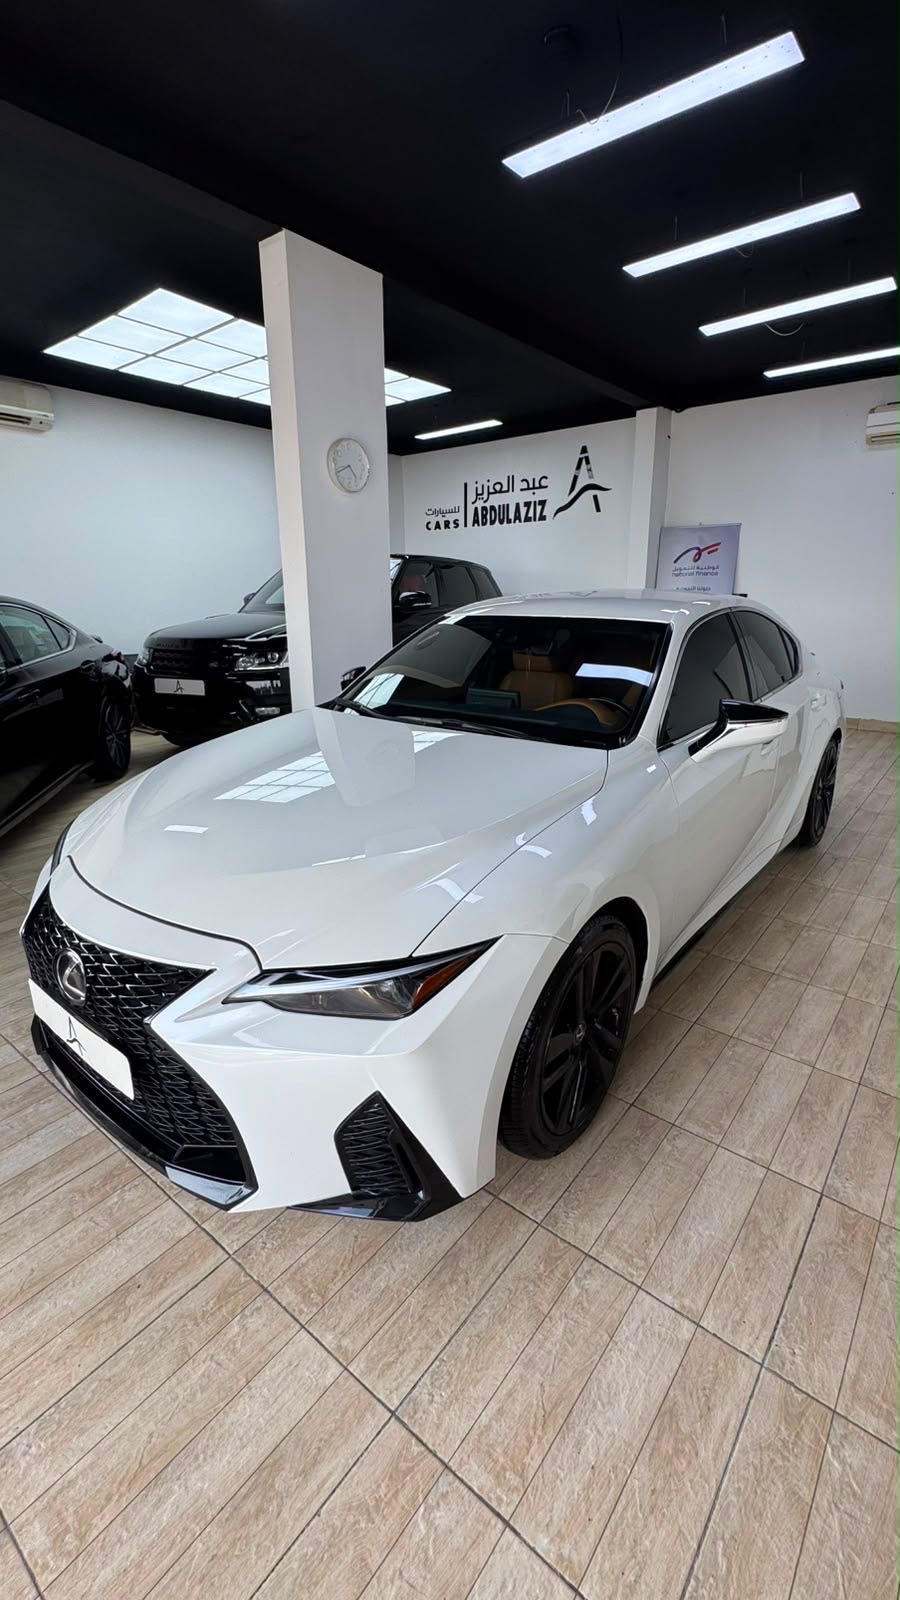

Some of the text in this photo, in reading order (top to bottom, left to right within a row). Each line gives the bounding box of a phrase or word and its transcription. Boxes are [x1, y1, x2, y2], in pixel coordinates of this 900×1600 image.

[472, 474, 549, 504] عبد العزيز
[425, 505, 460, 518] للسيارات
[472, 499, 547, 528] ABDULAZIZ
[425, 518, 460, 531] CARS
